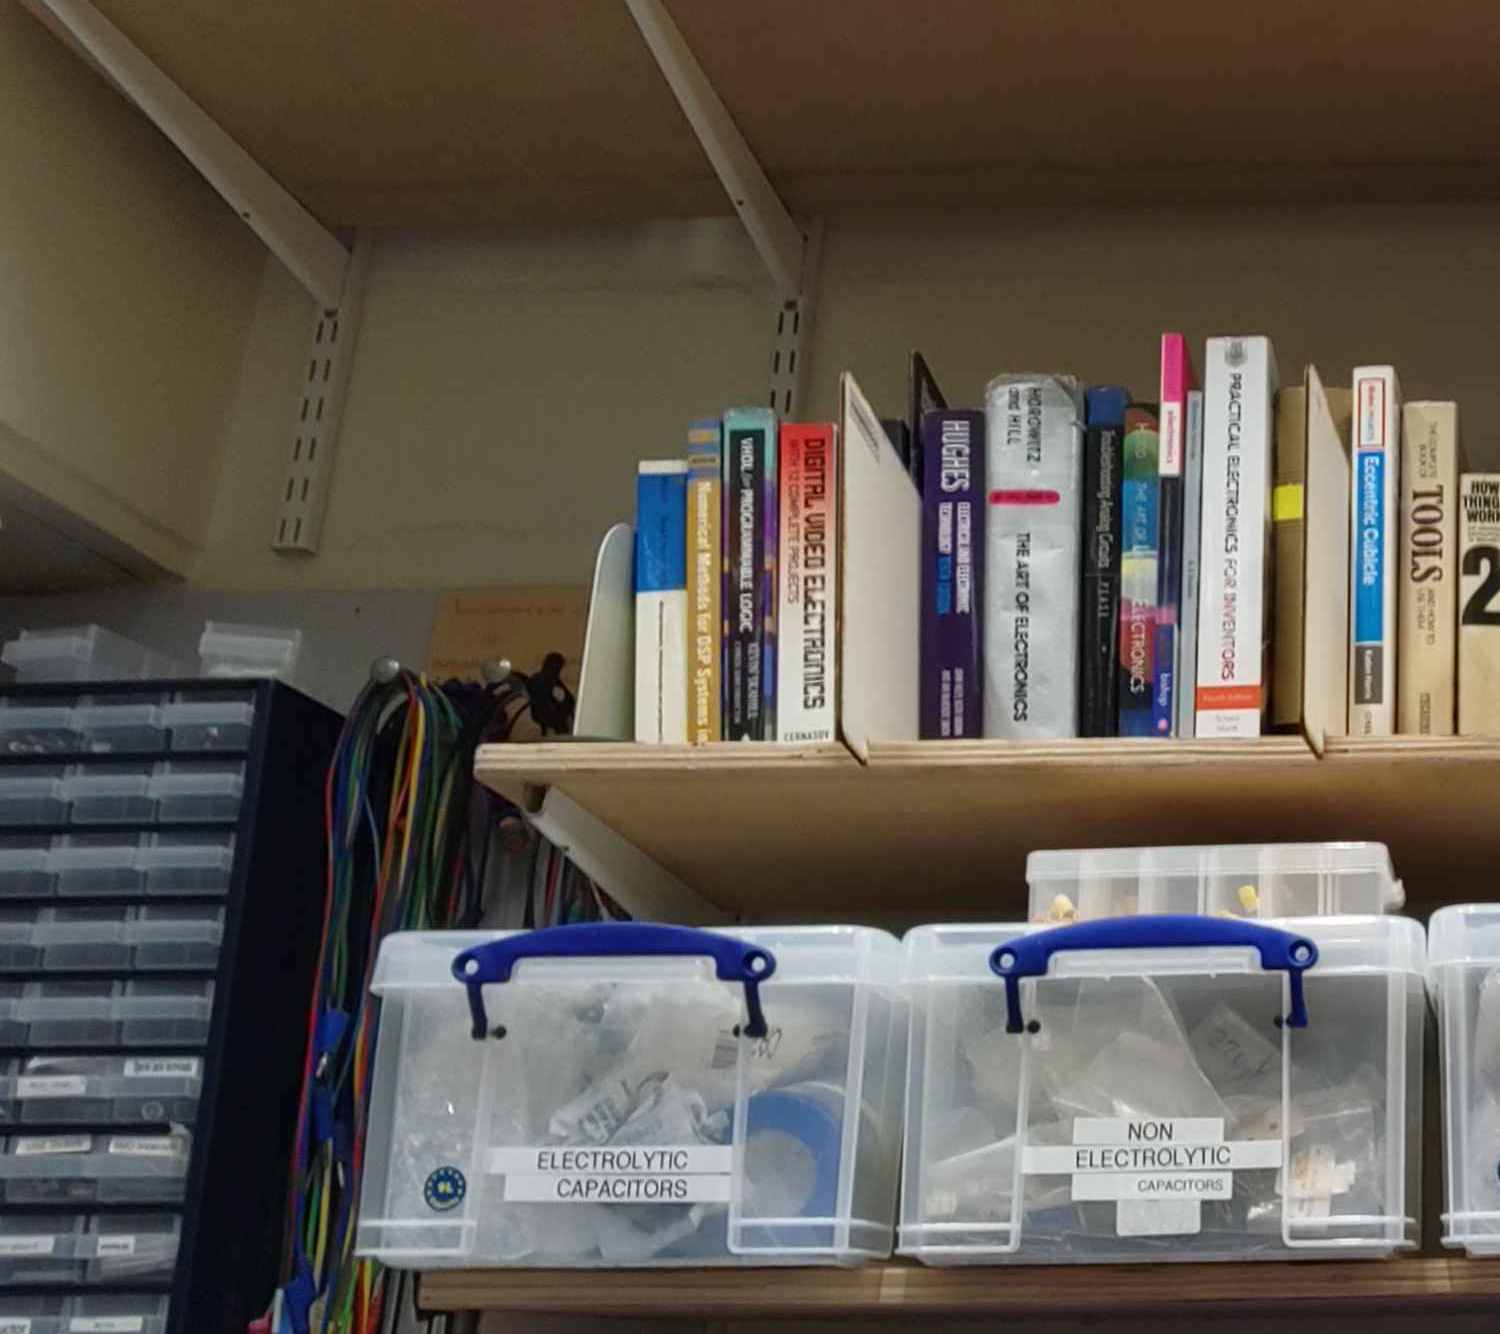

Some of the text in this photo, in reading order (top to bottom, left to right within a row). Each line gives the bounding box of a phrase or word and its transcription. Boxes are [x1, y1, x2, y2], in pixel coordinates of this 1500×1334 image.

[1025, 387, 1043, 463] HOROWITZ
[940, 419, 971, 493] HUGHES
[696, 481, 712, 547] Numerical
[788, 484, 798, 542] COMPLETE
[1471, 480, 1500, 494] HOW
[738, 436, 754, 632] VHDL PROGRAMMABLE LOGIC
[1221, 373, 1241, 679] PRACTICAL ELECTRONICS FOR INVENTORS
[1361, 457, 1380, 584] Eccentric Cubicle
[1409, 483, 1444, 582] TOOLS
[696, 553, 711, 609] Methods
[788, 545, 798, 603] PROJECTS
[803, 438, 824, 709] DIGITAL VIDEO ELECTRONICS
[696, 613, 711, 632] for
[1011, 532, 1030, 720] THE ART OF ELECTRONICS
[1129, 598, 1144, 692] ELECTRONICS
[693, 667, 710, 724] Systems
[537, 1150, 688, 1170] ELECTROLYTIC
[1075, 1146, 1231, 1169] ELECTROLYTIC
[1128, 1122, 1174, 1142] NON
[557, 1178, 688, 1198] CAPACITORS
[1137, 1179, 1224, 1192] CAPACITORS
